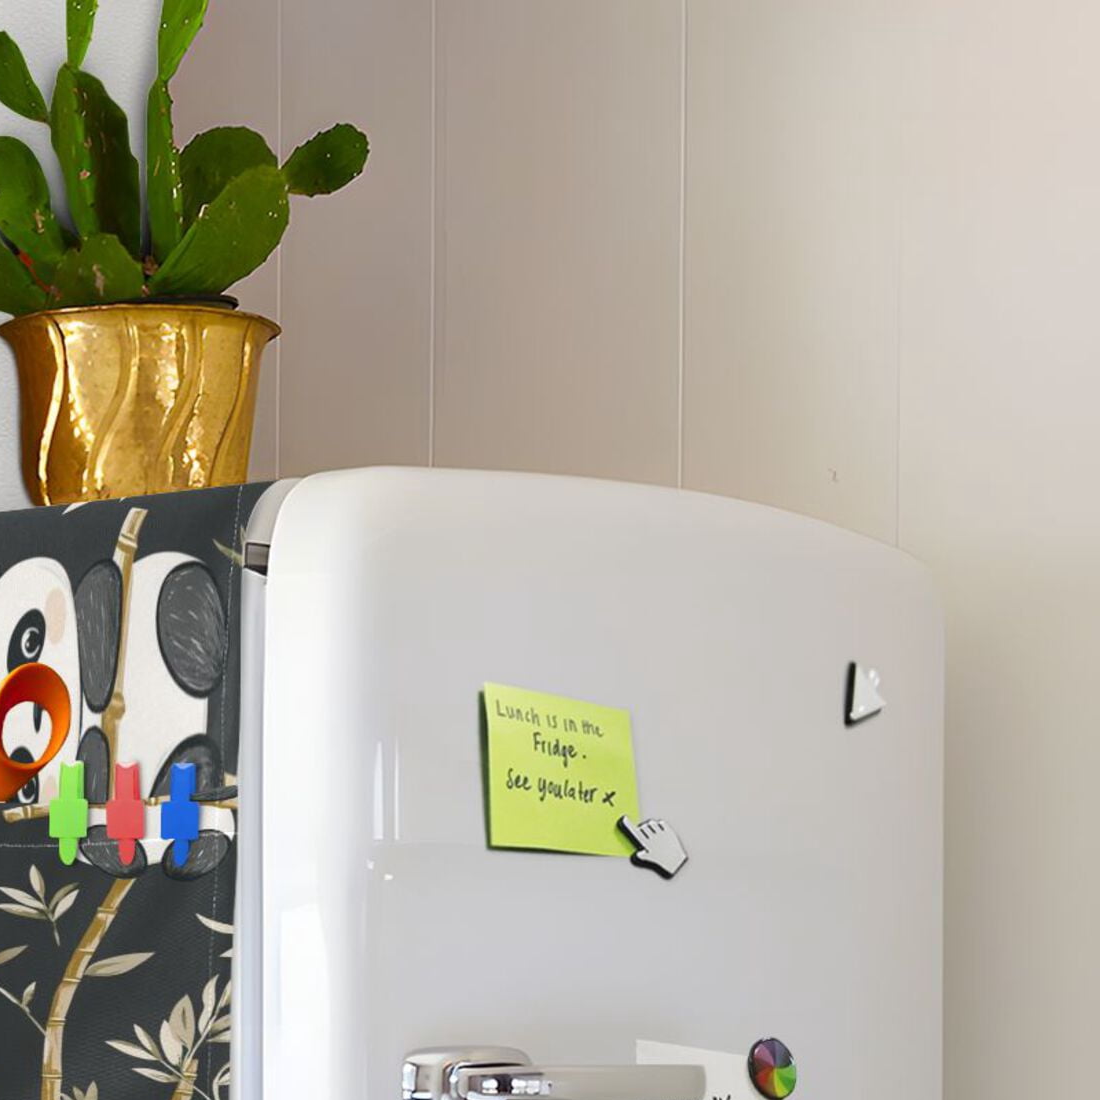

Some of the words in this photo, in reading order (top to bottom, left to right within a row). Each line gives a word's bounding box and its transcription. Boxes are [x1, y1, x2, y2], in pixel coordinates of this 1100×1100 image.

[496, 699, 540, 727] Lunch
[546, 714, 557, 728] is
[563, 718, 578, 733] in
[582, 720, 604, 738] the
[506, 768, 532, 790] See
